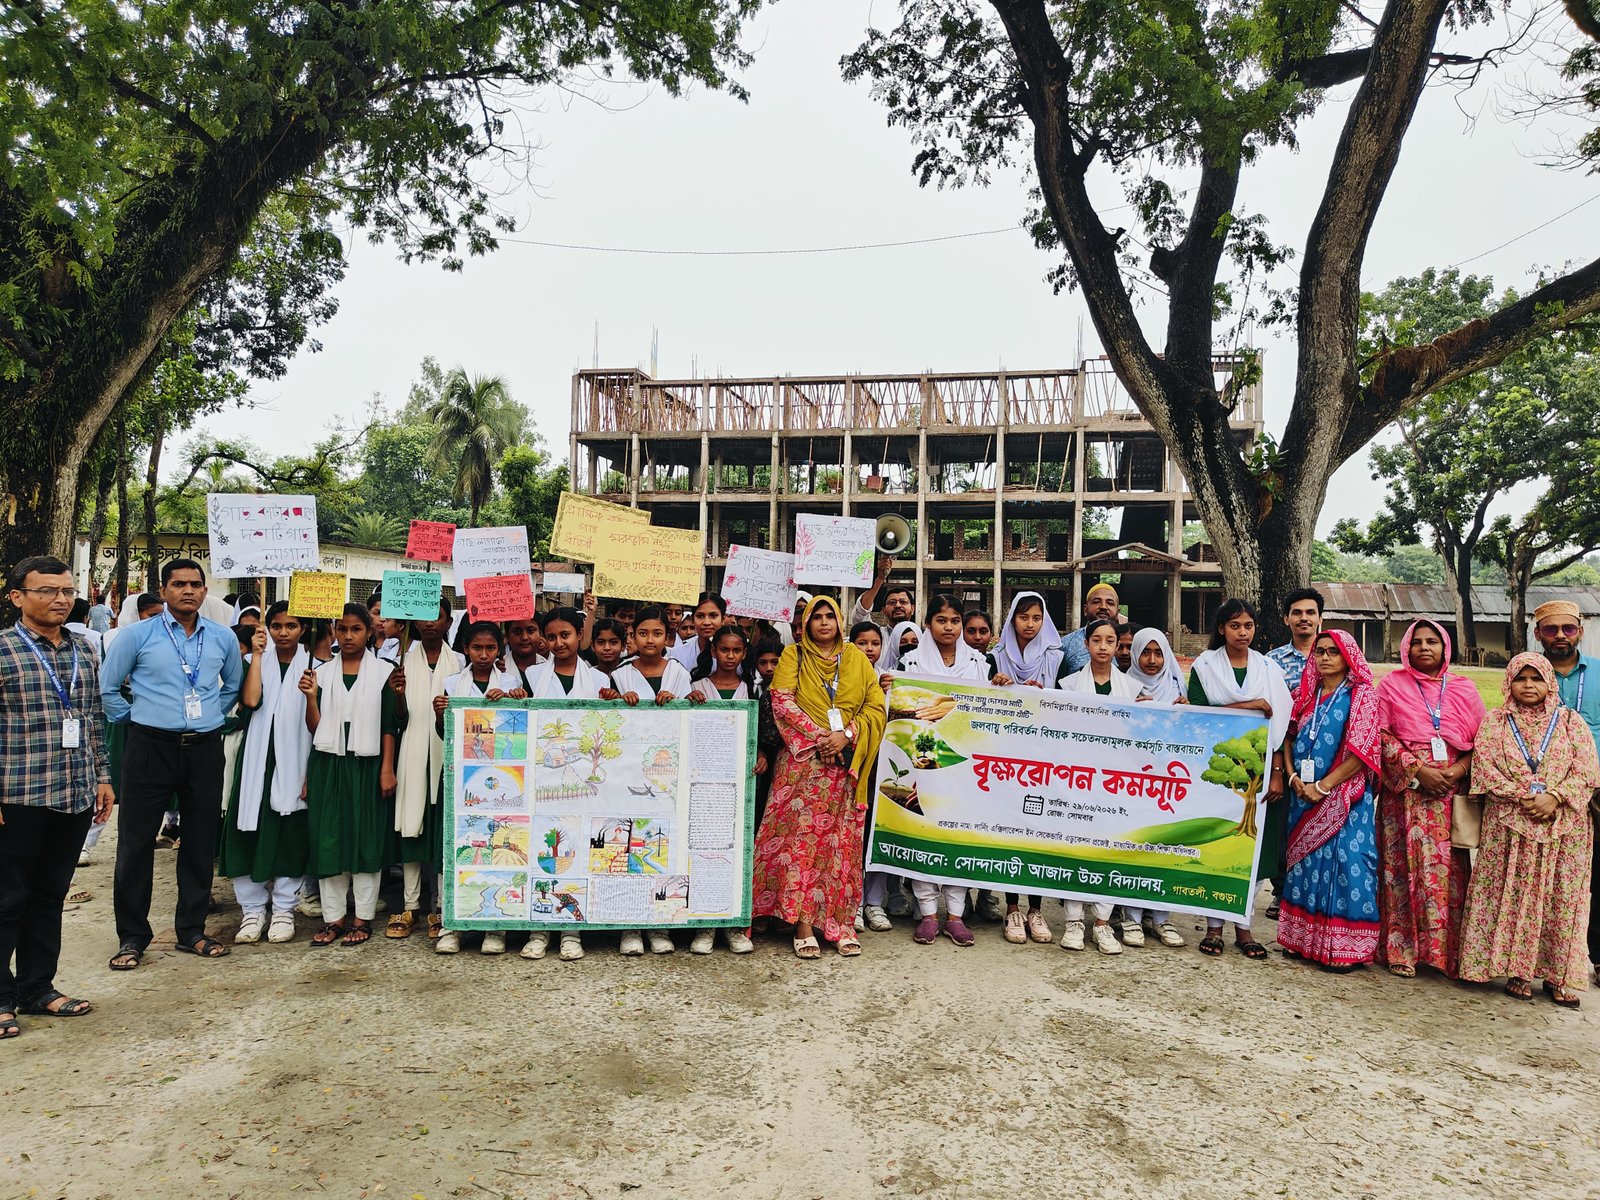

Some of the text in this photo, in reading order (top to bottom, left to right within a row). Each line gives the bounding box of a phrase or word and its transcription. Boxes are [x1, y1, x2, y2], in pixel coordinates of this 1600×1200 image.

[220, 507, 256, 521] গাছ
[286, 528, 315, 543] গাছ
[605, 559, 631, 572] সবুজ
[733, 554, 760, 575] গাছ
[389, 577, 406, 586] গাছ
[736, 576, 791, 599] পরিবেশ
[392, 589, 439, 599] ভরবো দেশ
[387, 600, 409, 611] সবুজ
[1040, 700, 1131, 719] বিসমিল্লাহির রহমানির রাহিম
[970, 721, 1205, 756] জলবায়ু পরিবর্তন বিষয়ক সচেতনতামূলক কর্মসূচি বাস্তবায়নে
[972, 753, 1192, 814] বৃক্ষরোপন কর্মসূচি
[1048, 798, 1070, 808] তারিখ:
[1047, 810, 1094, 822] রোজ: সোমবার
[878, 842, 949, 866] আয়োজনে:
[955, 856, 1024, 879] সোন্দাবাড়ী
[1027, 863, 1074, 882] আজাদ
[1078, 867, 1105, 885] উচ্চ
[1109, 869, 1167, 897] বিদ্যালয়,
[1173, 885, 1208, 900] গাবতলী,
